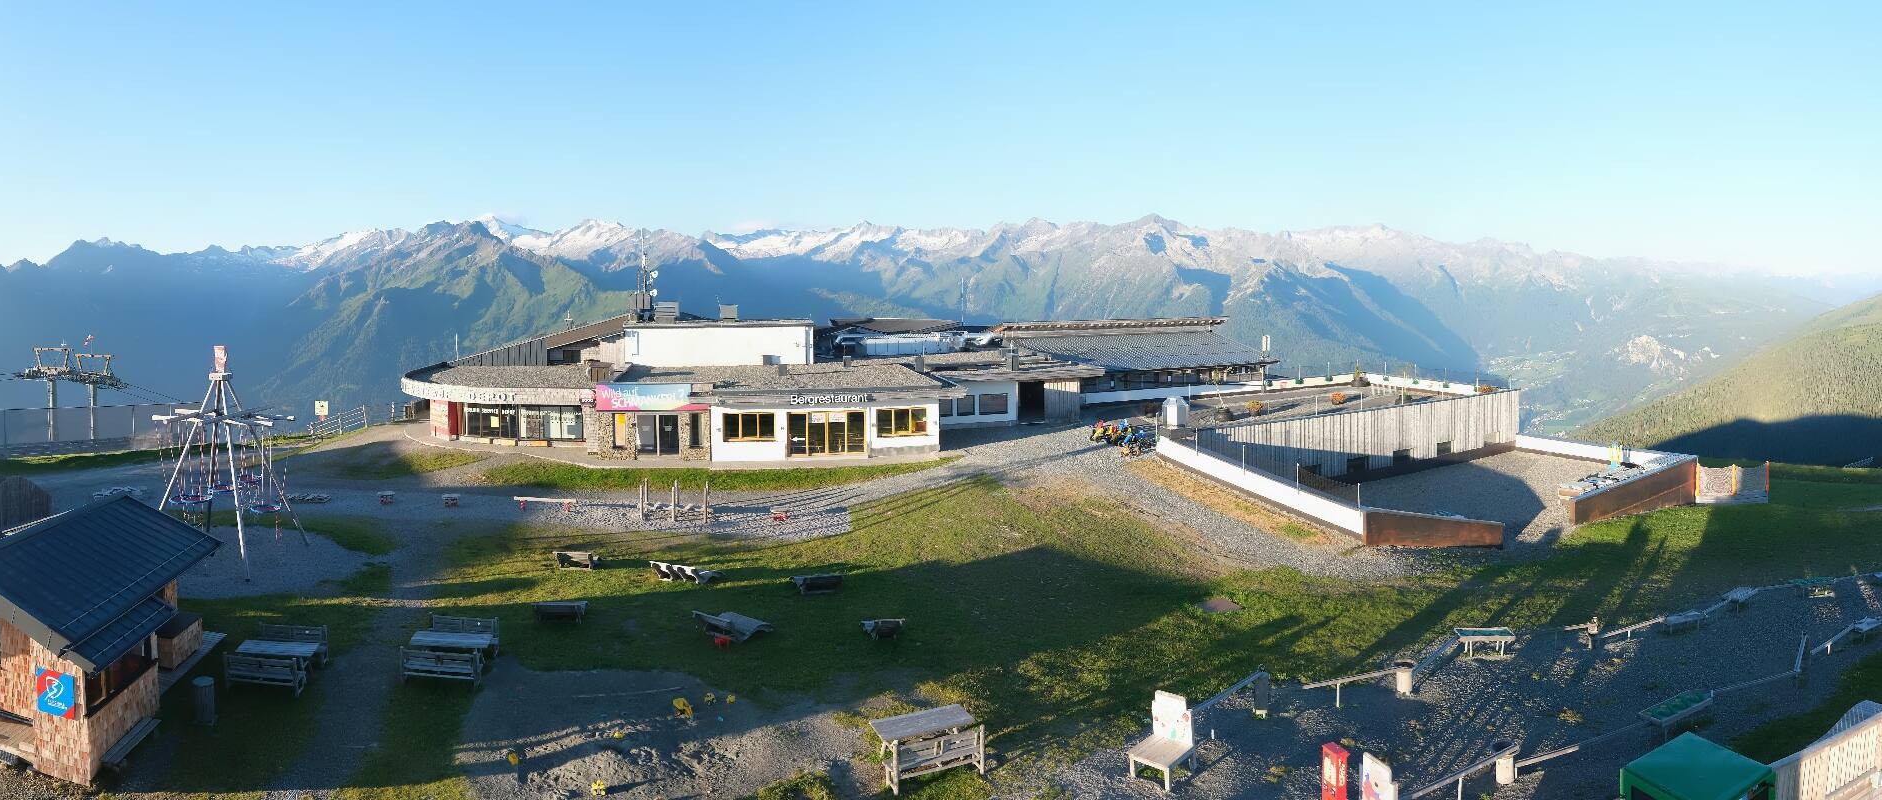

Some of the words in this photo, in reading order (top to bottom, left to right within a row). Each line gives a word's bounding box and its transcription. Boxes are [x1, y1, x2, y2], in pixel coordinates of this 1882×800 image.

[469, 393, 517, 402] DEPOT
[602, 388, 621, 399] Wild
[790, 393, 868, 406] Bergrestaurant
